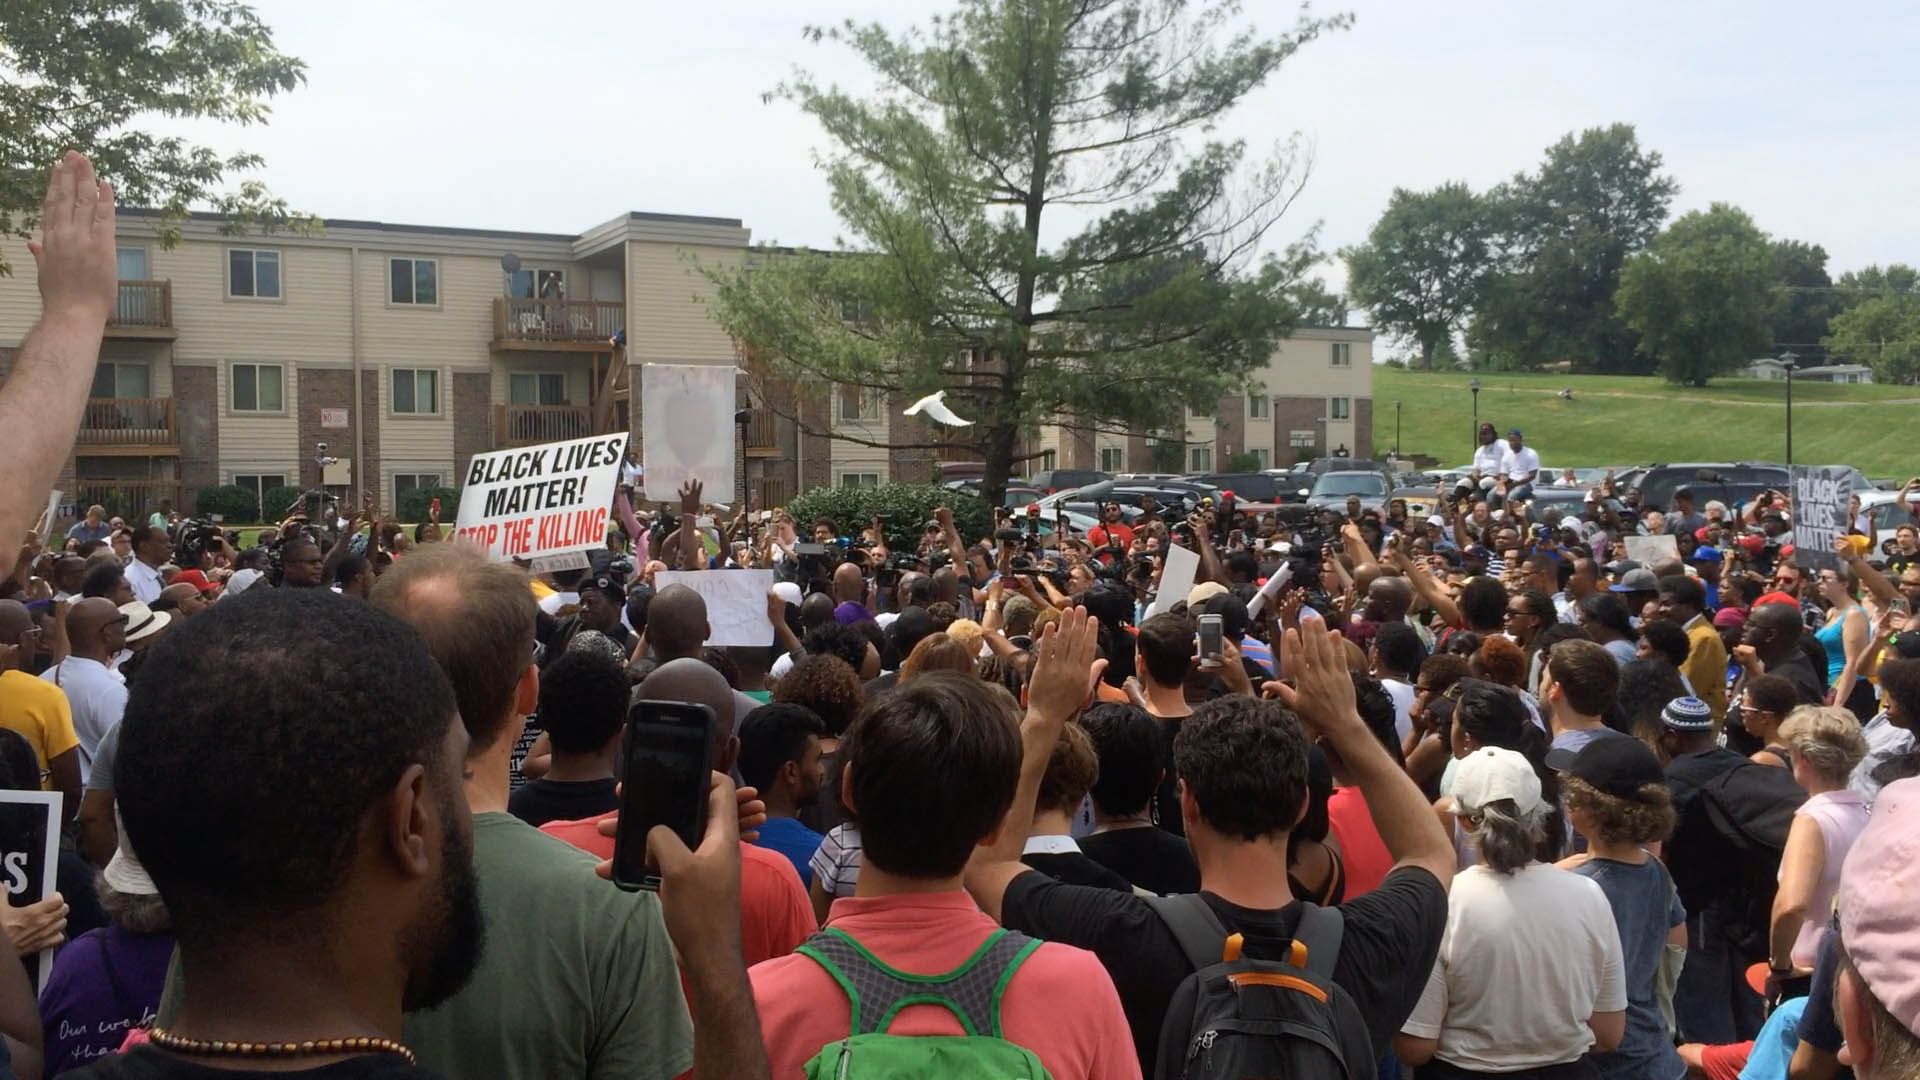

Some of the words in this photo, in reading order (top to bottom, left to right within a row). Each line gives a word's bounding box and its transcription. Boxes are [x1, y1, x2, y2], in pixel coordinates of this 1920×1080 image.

[468, 449, 548, 486] BLACK
[551, 438, 622, 474] LIVES
[483, 475, 589, 518] MATTER!
[1797, 477, 1840, 505] BLACK
[457, 523, 499, 548] TOP
[502, 518, 534, 556] THE
[536, 506, 607, 551] KILLING
[1800, 503, 1836, 528] LIVES
[1796, 526, 1835, 552] MATTE
[0, 851, 28, 895] S
[59, 1020, 87, 1040] Our
